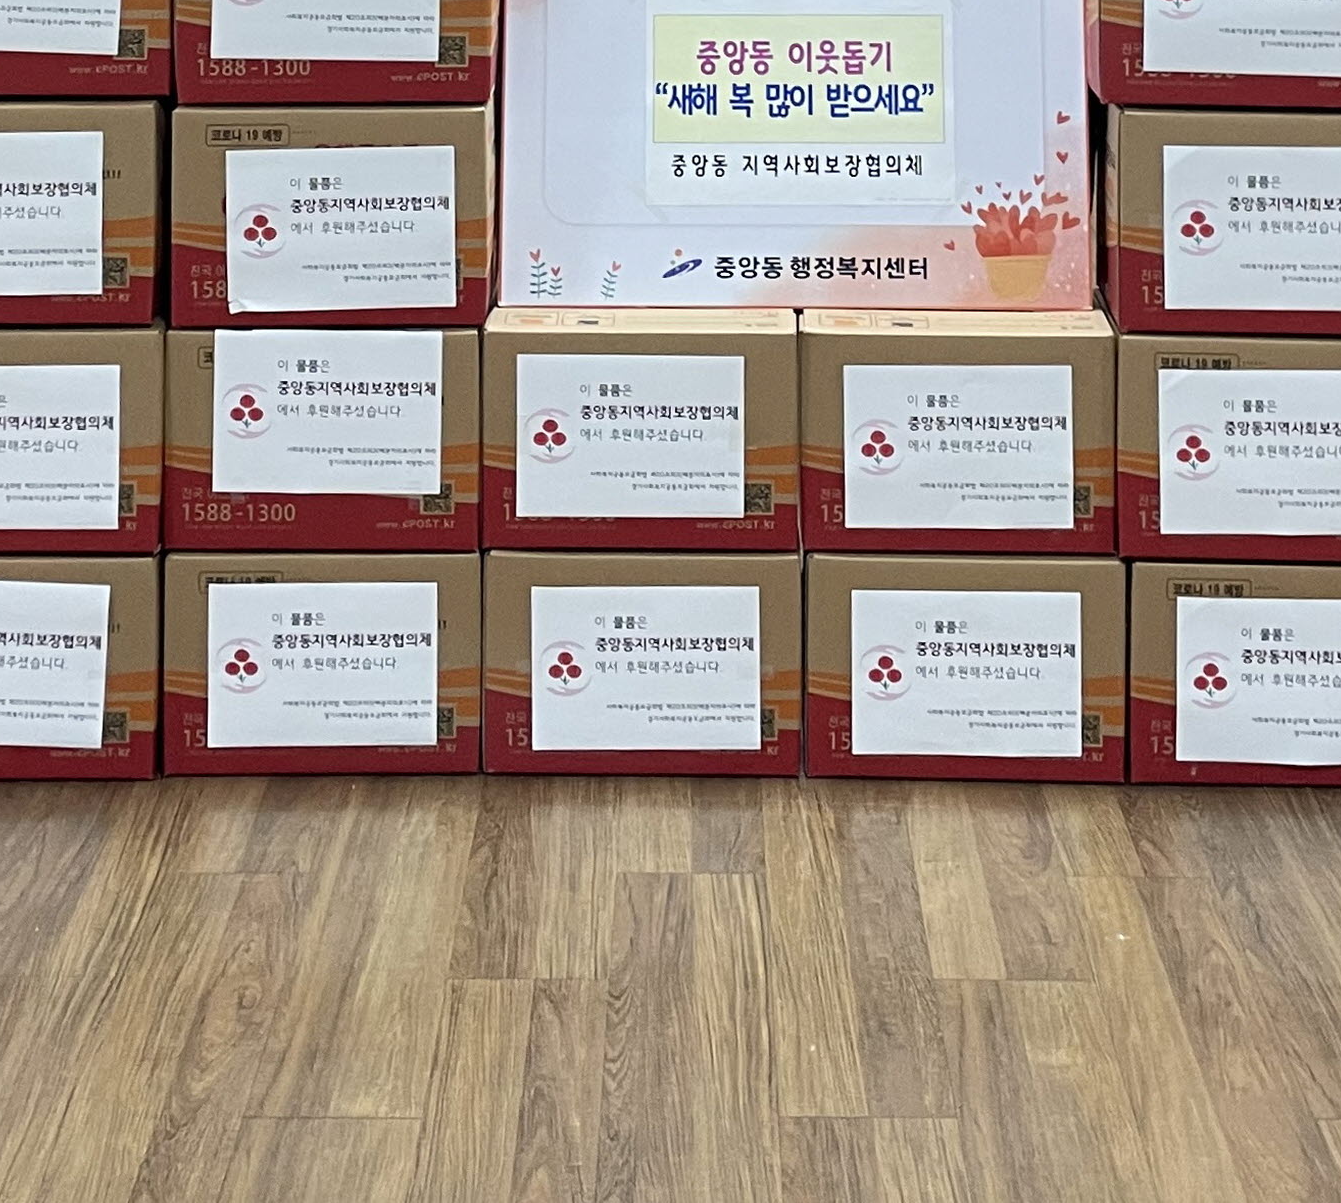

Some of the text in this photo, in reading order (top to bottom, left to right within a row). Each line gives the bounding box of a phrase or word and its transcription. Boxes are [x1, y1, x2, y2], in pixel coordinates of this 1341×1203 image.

[696, 40, 892, 75] 중앙동 이웃돕기
[197, 58, 311, 77] 1588-1300
[655, 82, 934, 118] “새해 복 많이 받으세요”
[671, 154, 923, 178] 중앙동 지역사회보장협의체
[291, 195, 449, 214] 중앙동지역사회보장협의체
[714, 256, 928, 279] 중앙동 행정복지센터
[278, 381, 436, 397] 중앙동지역사회보장협의체
[277, 404, 300, 417] 에서
[581, 405, 738, 420] 중앙동지역사회보장협의체
[908, 415, 1067, 431] 중앙동지역사회보장협의체
[580, 429, 602, 441] 에서
[182, 503, 296, 522] 1588-1300
[273, 632, 432, 649] 중앙동지역사회보장협의체
[596, 636, 754, 652] 중앙동지역사회보장협의체
[916, 642, 1076, 658] 중앙동지역사회보장협의체
[916, 665, 938, 678] 에서
